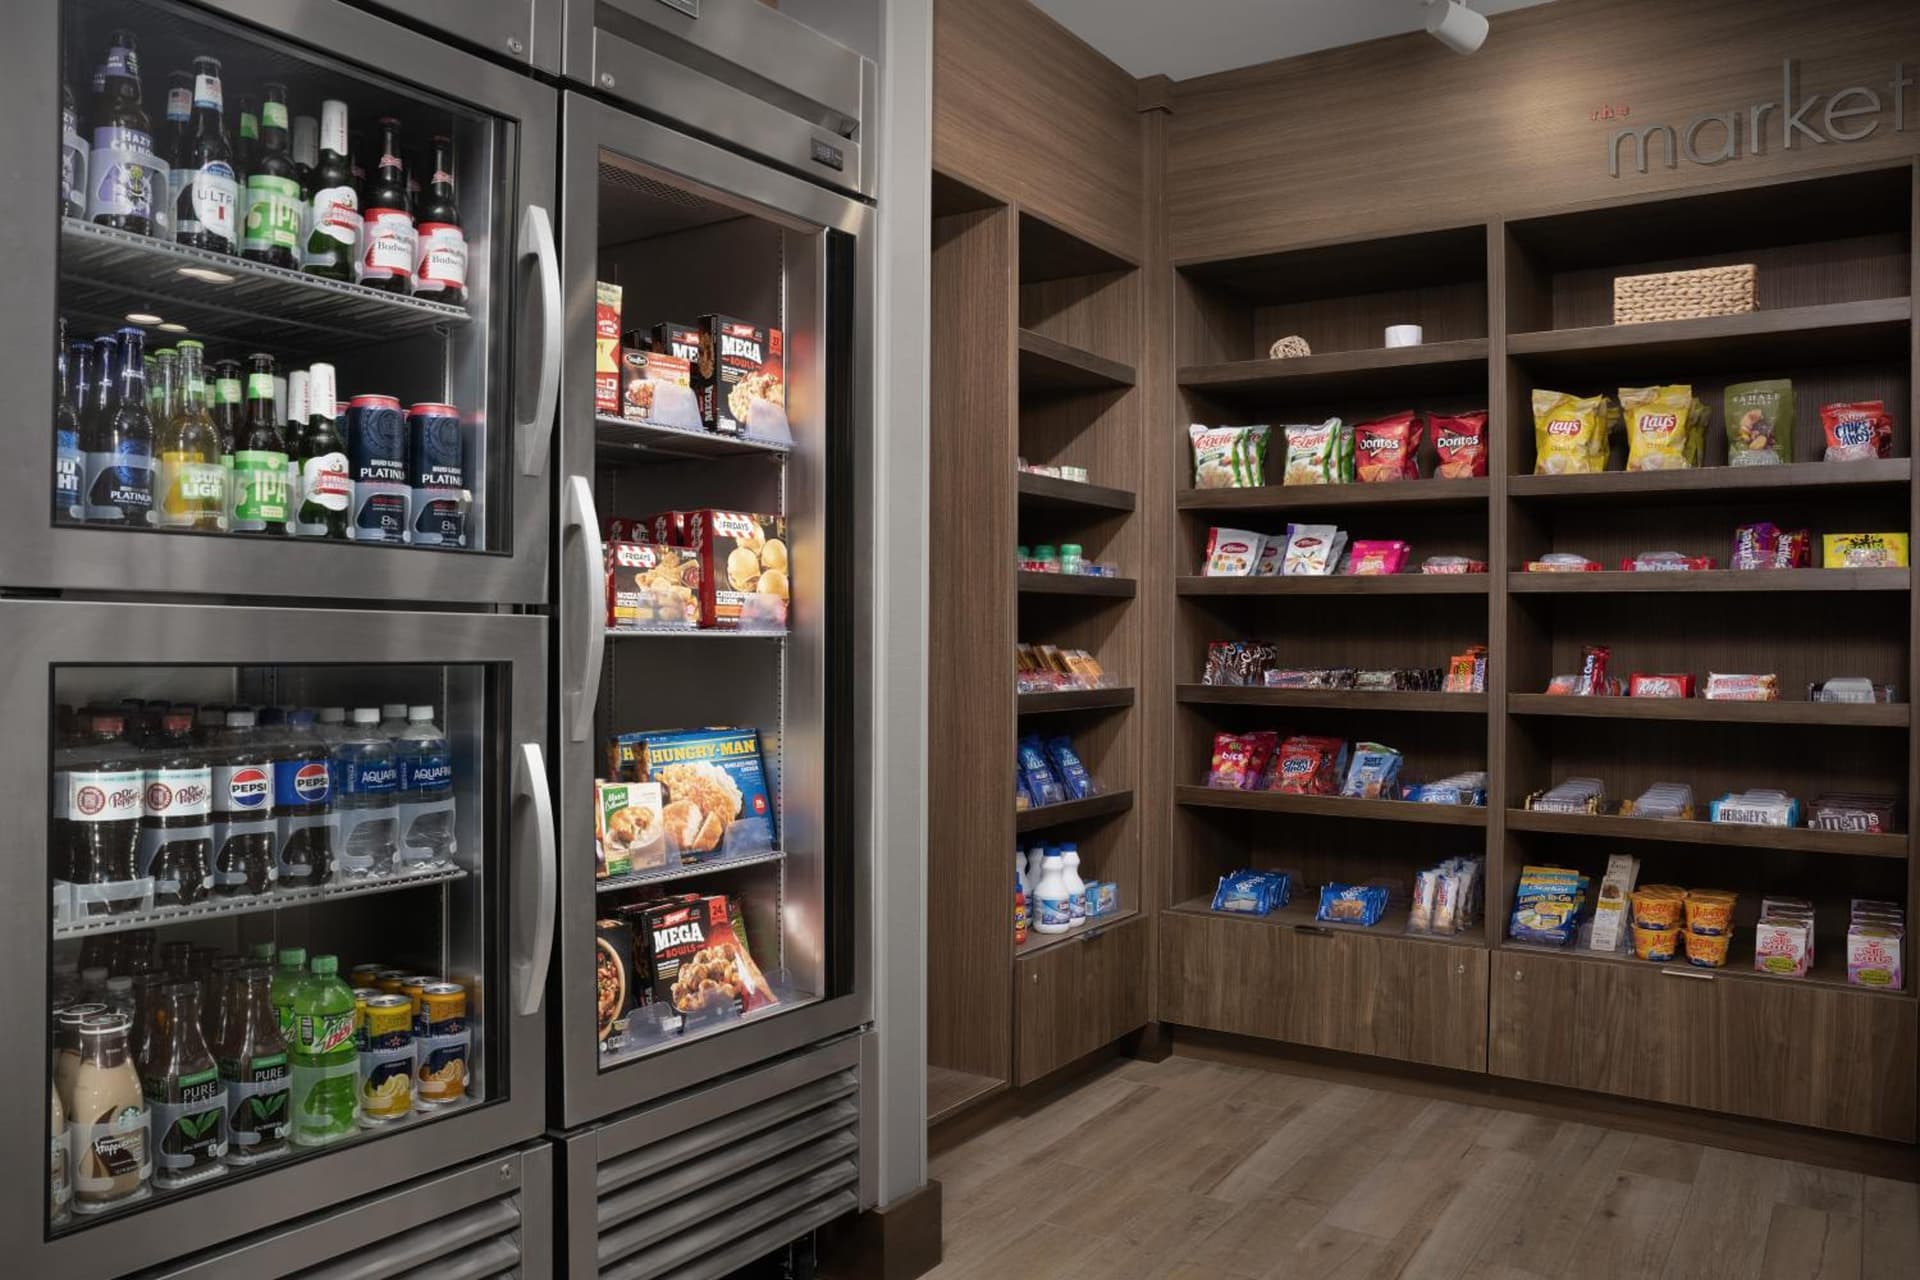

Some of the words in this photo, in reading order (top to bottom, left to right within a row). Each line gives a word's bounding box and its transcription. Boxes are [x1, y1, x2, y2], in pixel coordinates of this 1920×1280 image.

[1608, 57, 1913, 178] market
[721, 334, 762, 365] MEGA
[1360, 438, 1399, 450] Doritos
[1437, 434, 1479, 449] Doritos
[254, 470, 287, 504] IPA
[232, 782, 268, 793] PEPSI
[653, 922, 705, 953] MEGA
[256, 1066, 284, 1081] PURE
[183, 1080, 216, 1100] PURE
